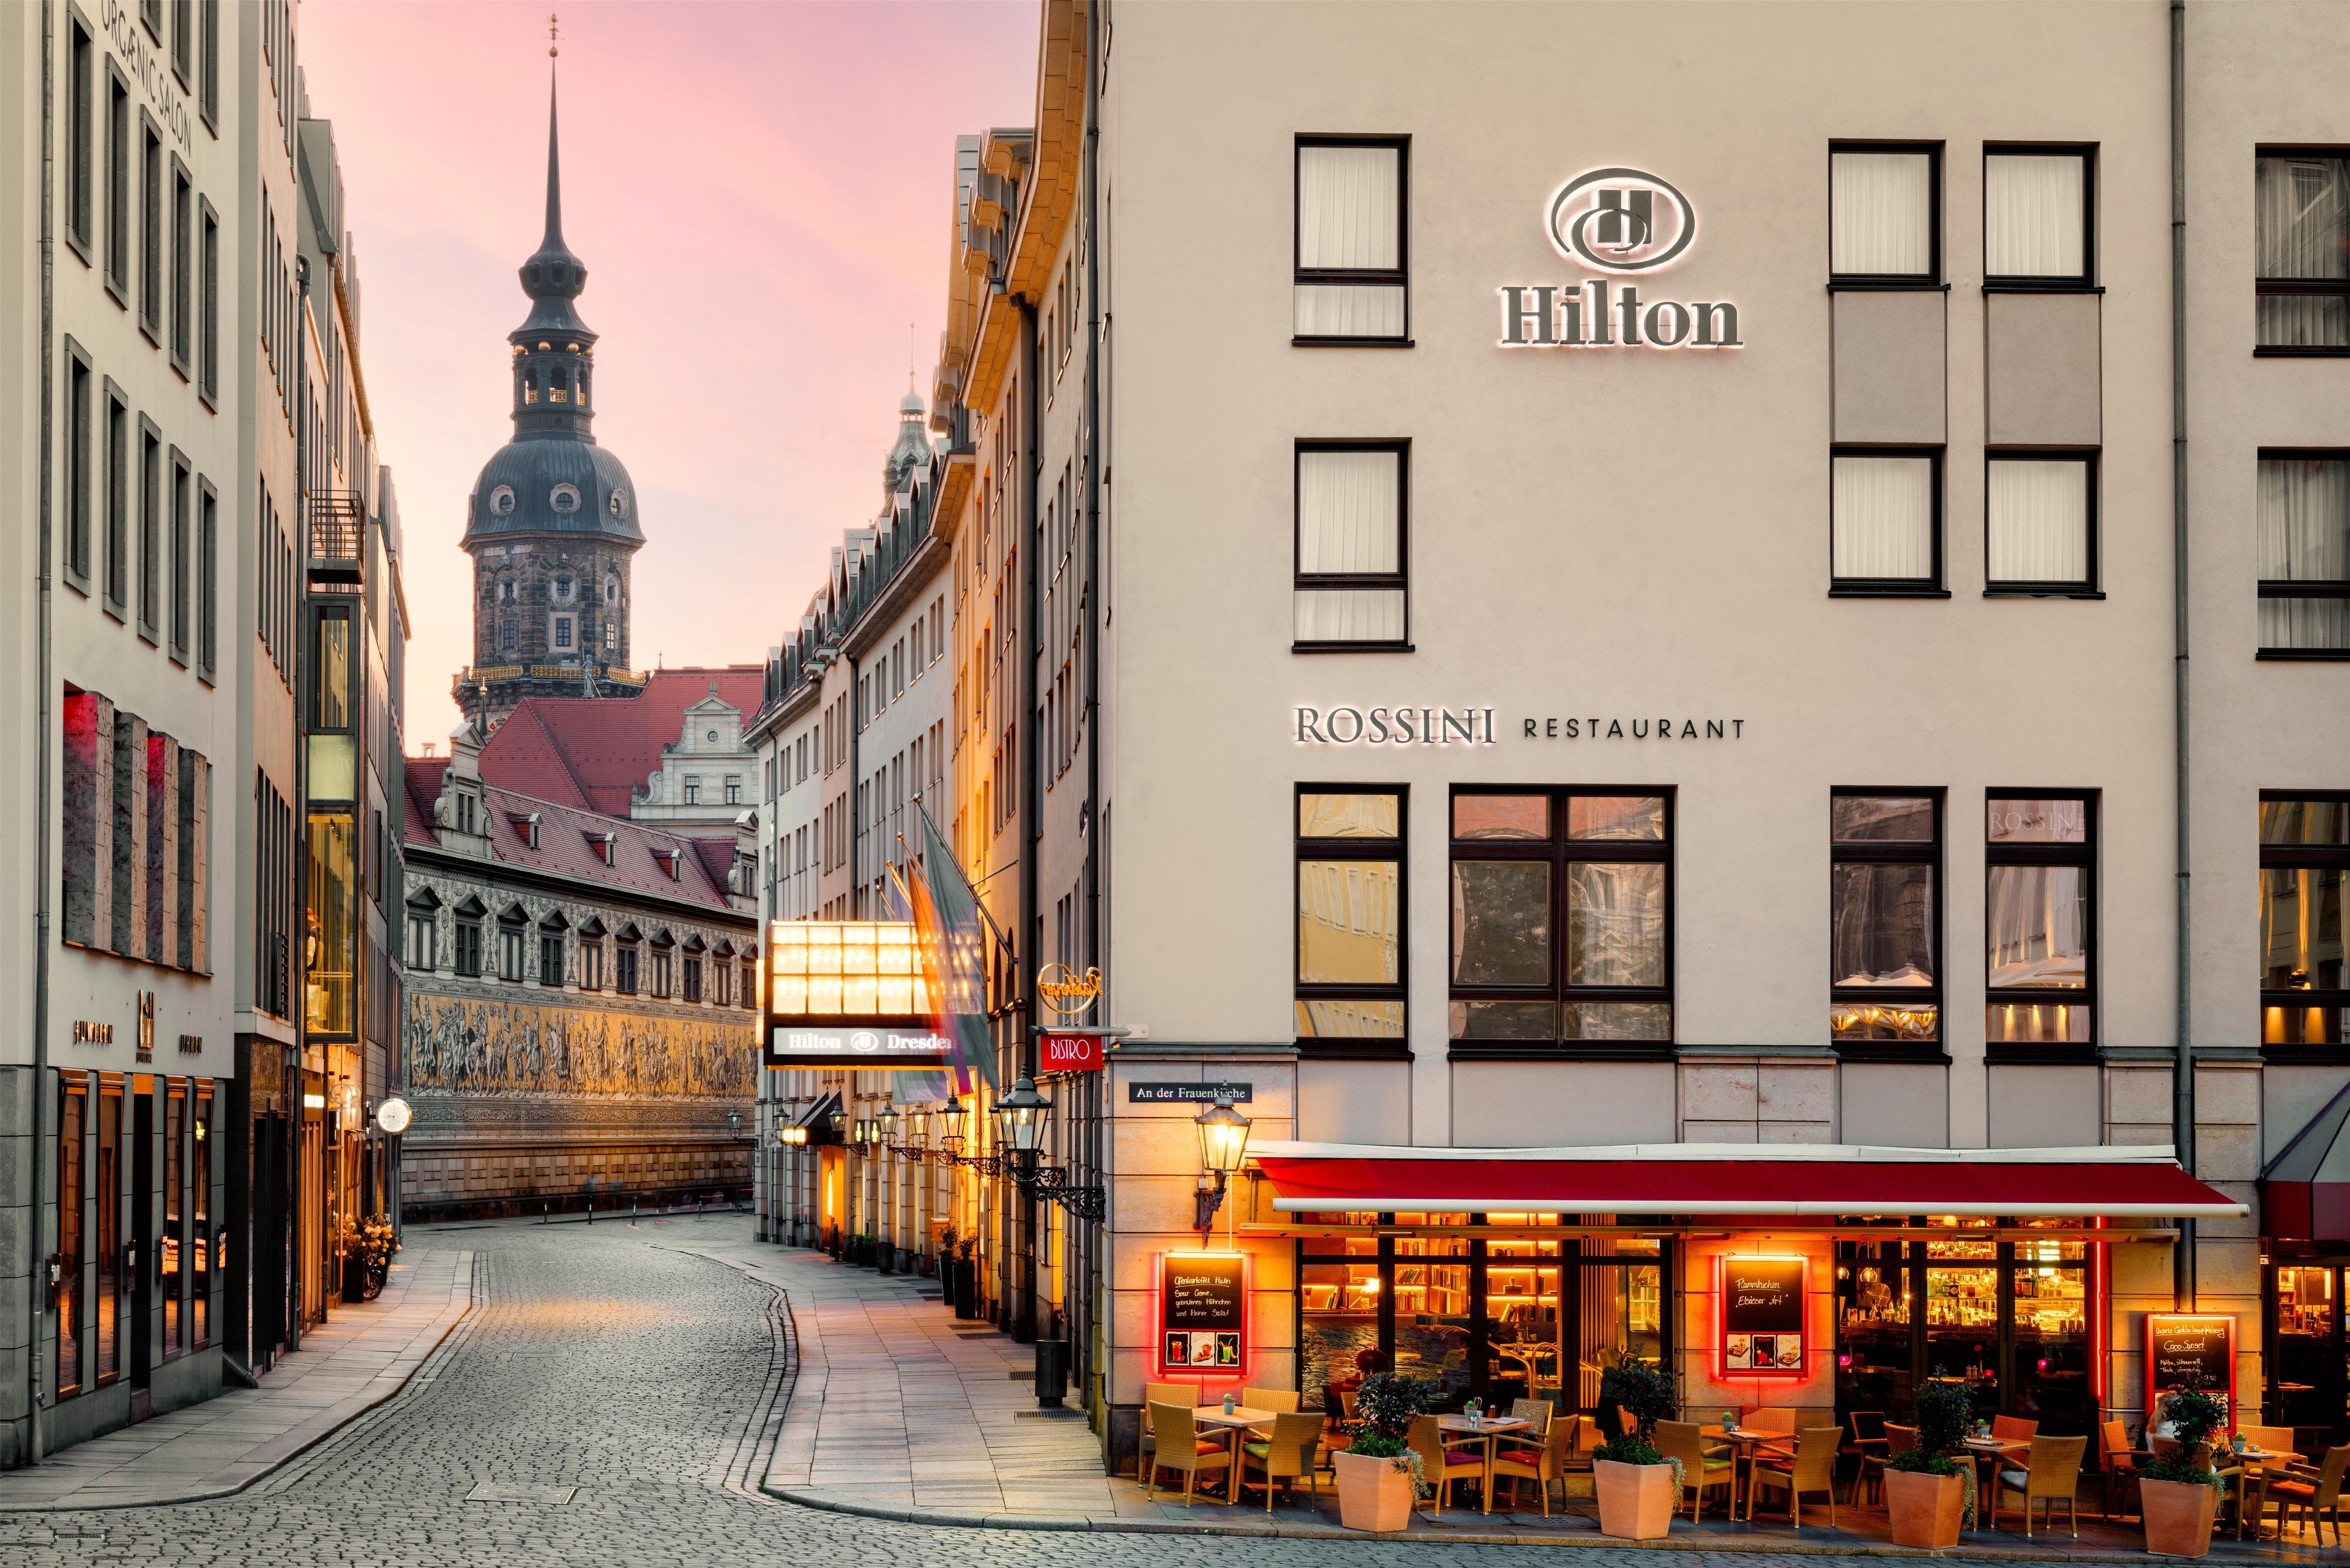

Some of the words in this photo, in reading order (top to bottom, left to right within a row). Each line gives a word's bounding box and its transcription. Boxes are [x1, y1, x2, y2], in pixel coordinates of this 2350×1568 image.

[159, 72, 191, 159] SALON
[1501, 280, 1744, 346] Hilton
[1293, 707, 1496, 744] ROSSINI
[1524, 718, 1745, 739] RESTAURANT
[1990, 812, 2084, 831] ROSSINI
[179, 1034, 203, 1054] UHREN
[788, 1033, 842, 1049] Hilton
[1050, 1039, 1090, 1060] BISTRO
[1136, 1088, 1152, 1098] An
[1157, 1088, 1174, 1098] der
[1178, 1088, 1245, 1098] Frauenkiche
[2163, 1340, 2182, 1351] Coco
[2182, 1337, 2206, 1350] Sunset
